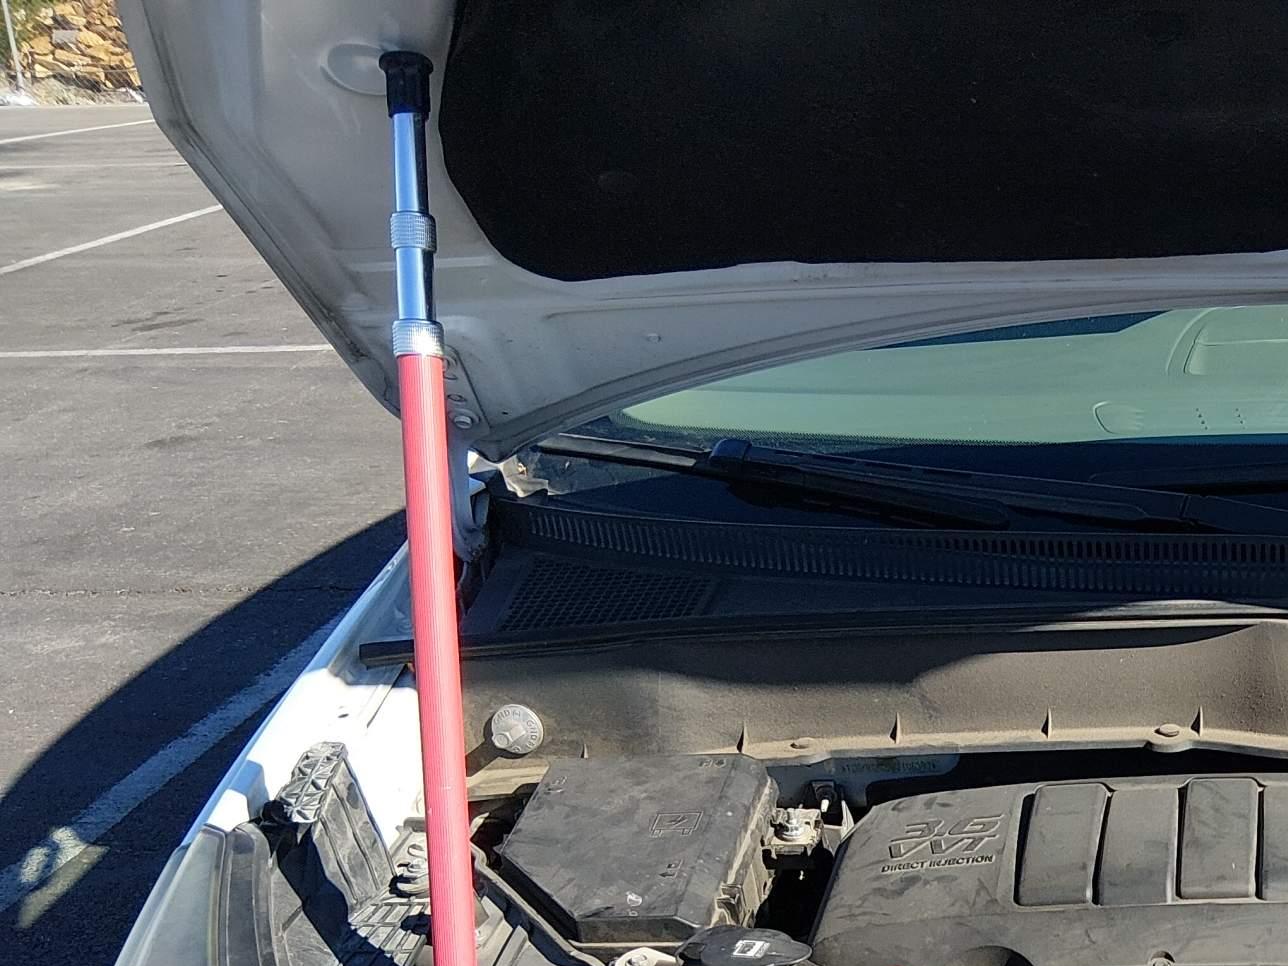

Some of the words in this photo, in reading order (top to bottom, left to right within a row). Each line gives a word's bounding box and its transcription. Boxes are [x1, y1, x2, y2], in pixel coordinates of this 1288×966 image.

[888, 835, 1000, 859] VVT
[881, 860, 927, 873] DIRECT
[928, 854, 995, 869] INJECTION
